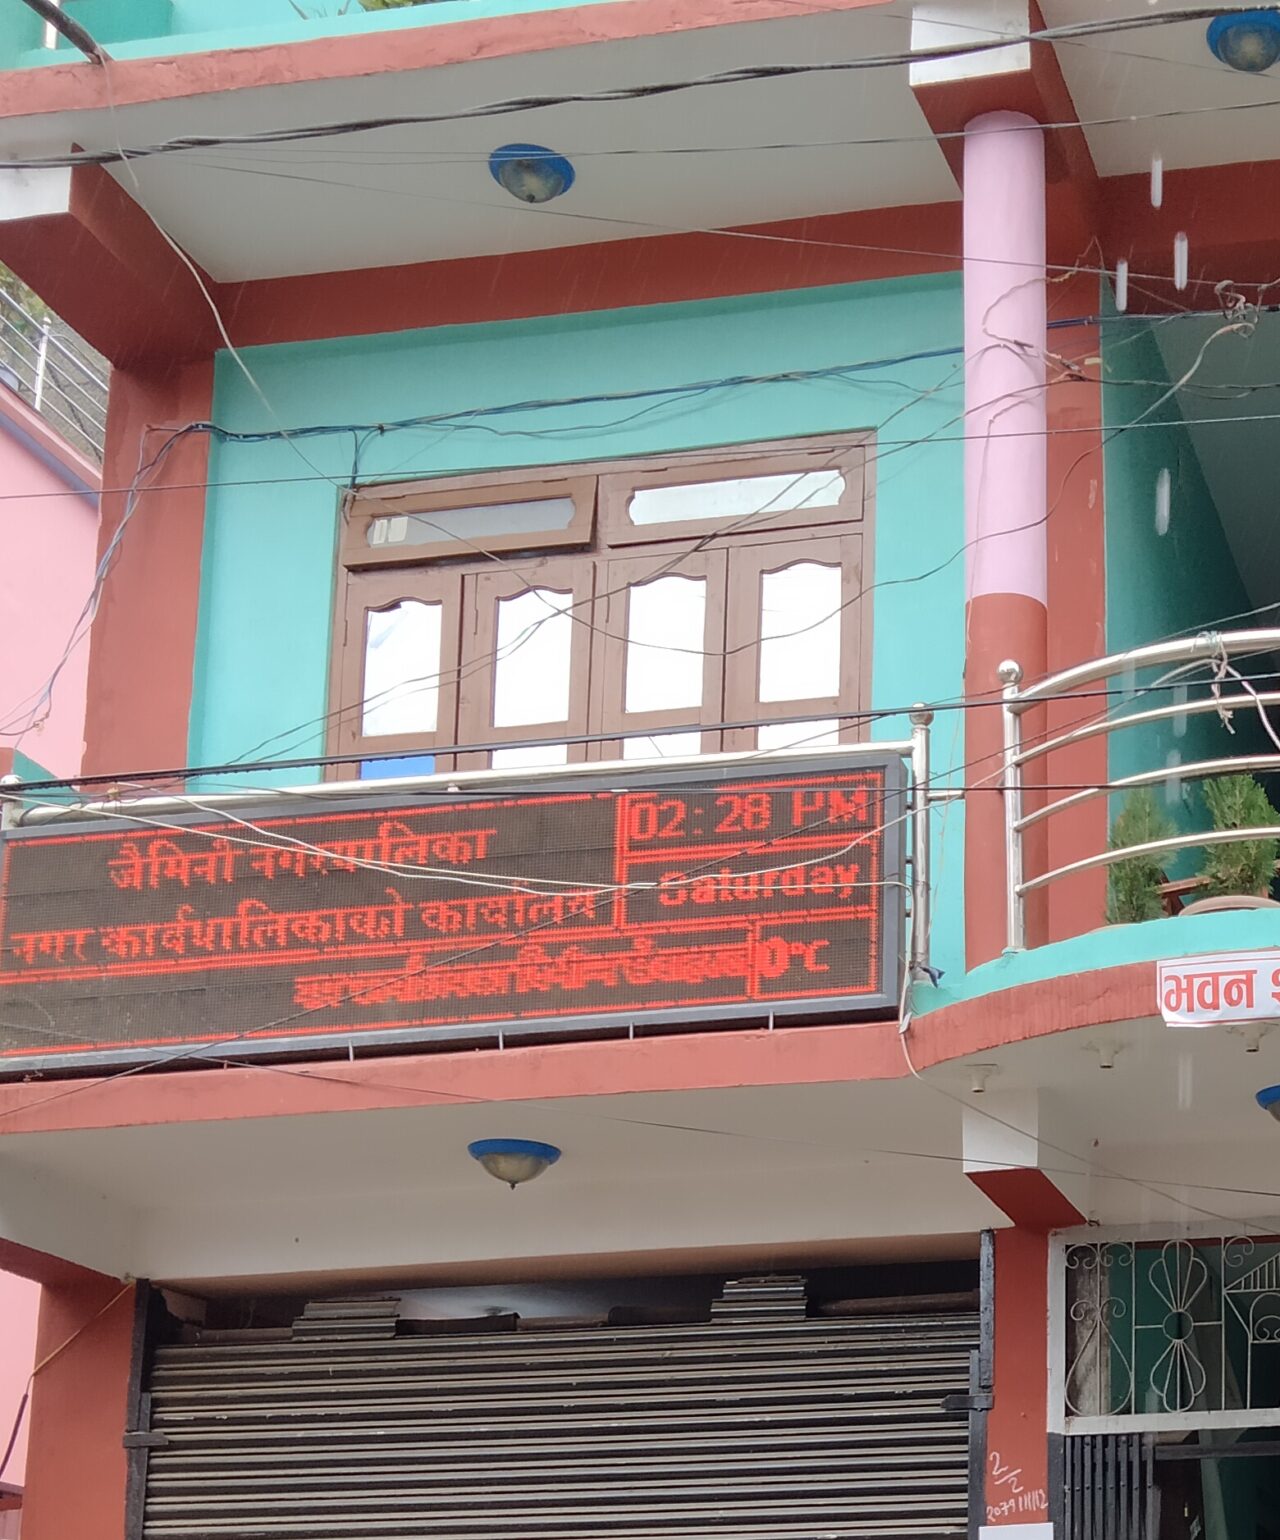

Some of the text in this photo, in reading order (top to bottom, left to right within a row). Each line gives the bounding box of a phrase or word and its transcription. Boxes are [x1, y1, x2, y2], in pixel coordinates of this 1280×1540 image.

[792, 785, 868, 827] PM
[107, 837, 243, 891] जैमिनी
[658, 864, 861, 907] Saturday
[10, 927, 95, 965] नगर
[1163, 969, 1258, 1013] भवन
